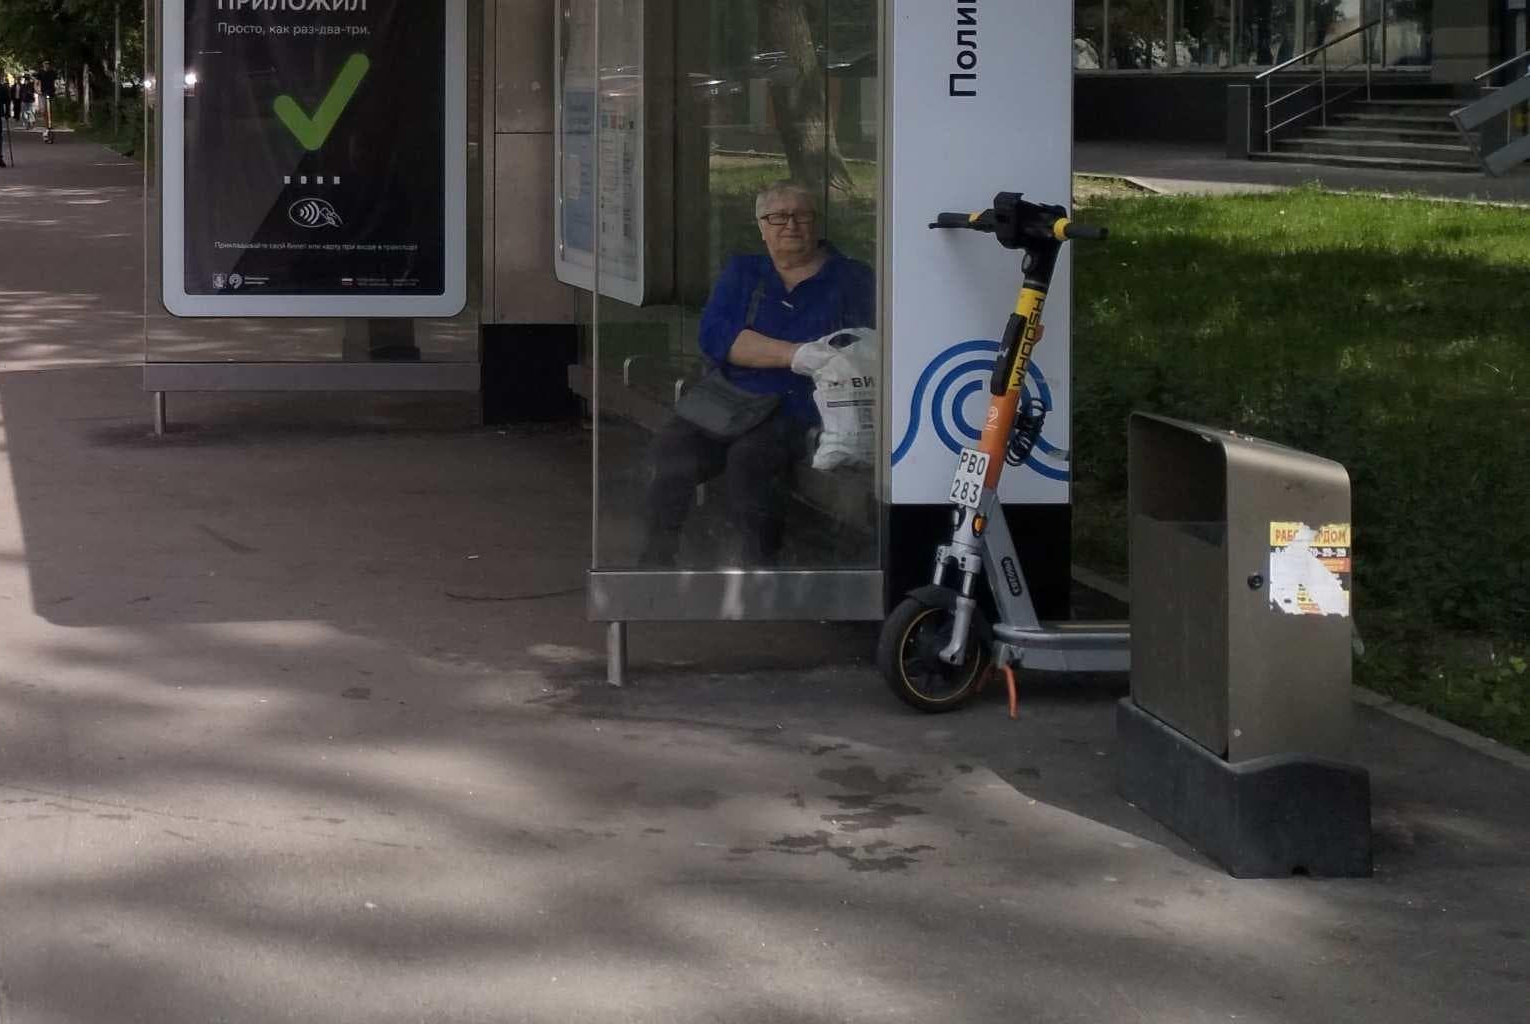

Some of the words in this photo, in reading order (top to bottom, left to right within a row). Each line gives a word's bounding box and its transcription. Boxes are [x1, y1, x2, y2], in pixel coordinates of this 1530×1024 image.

[218, 22, 266, 36] Просто,
[269, 25, 289, 34] как
[293, 25, 371, 36] раз-два-три.
[1013, 297, 1045, 387] WHOOSH
[951, 479, 980, 503] 283
